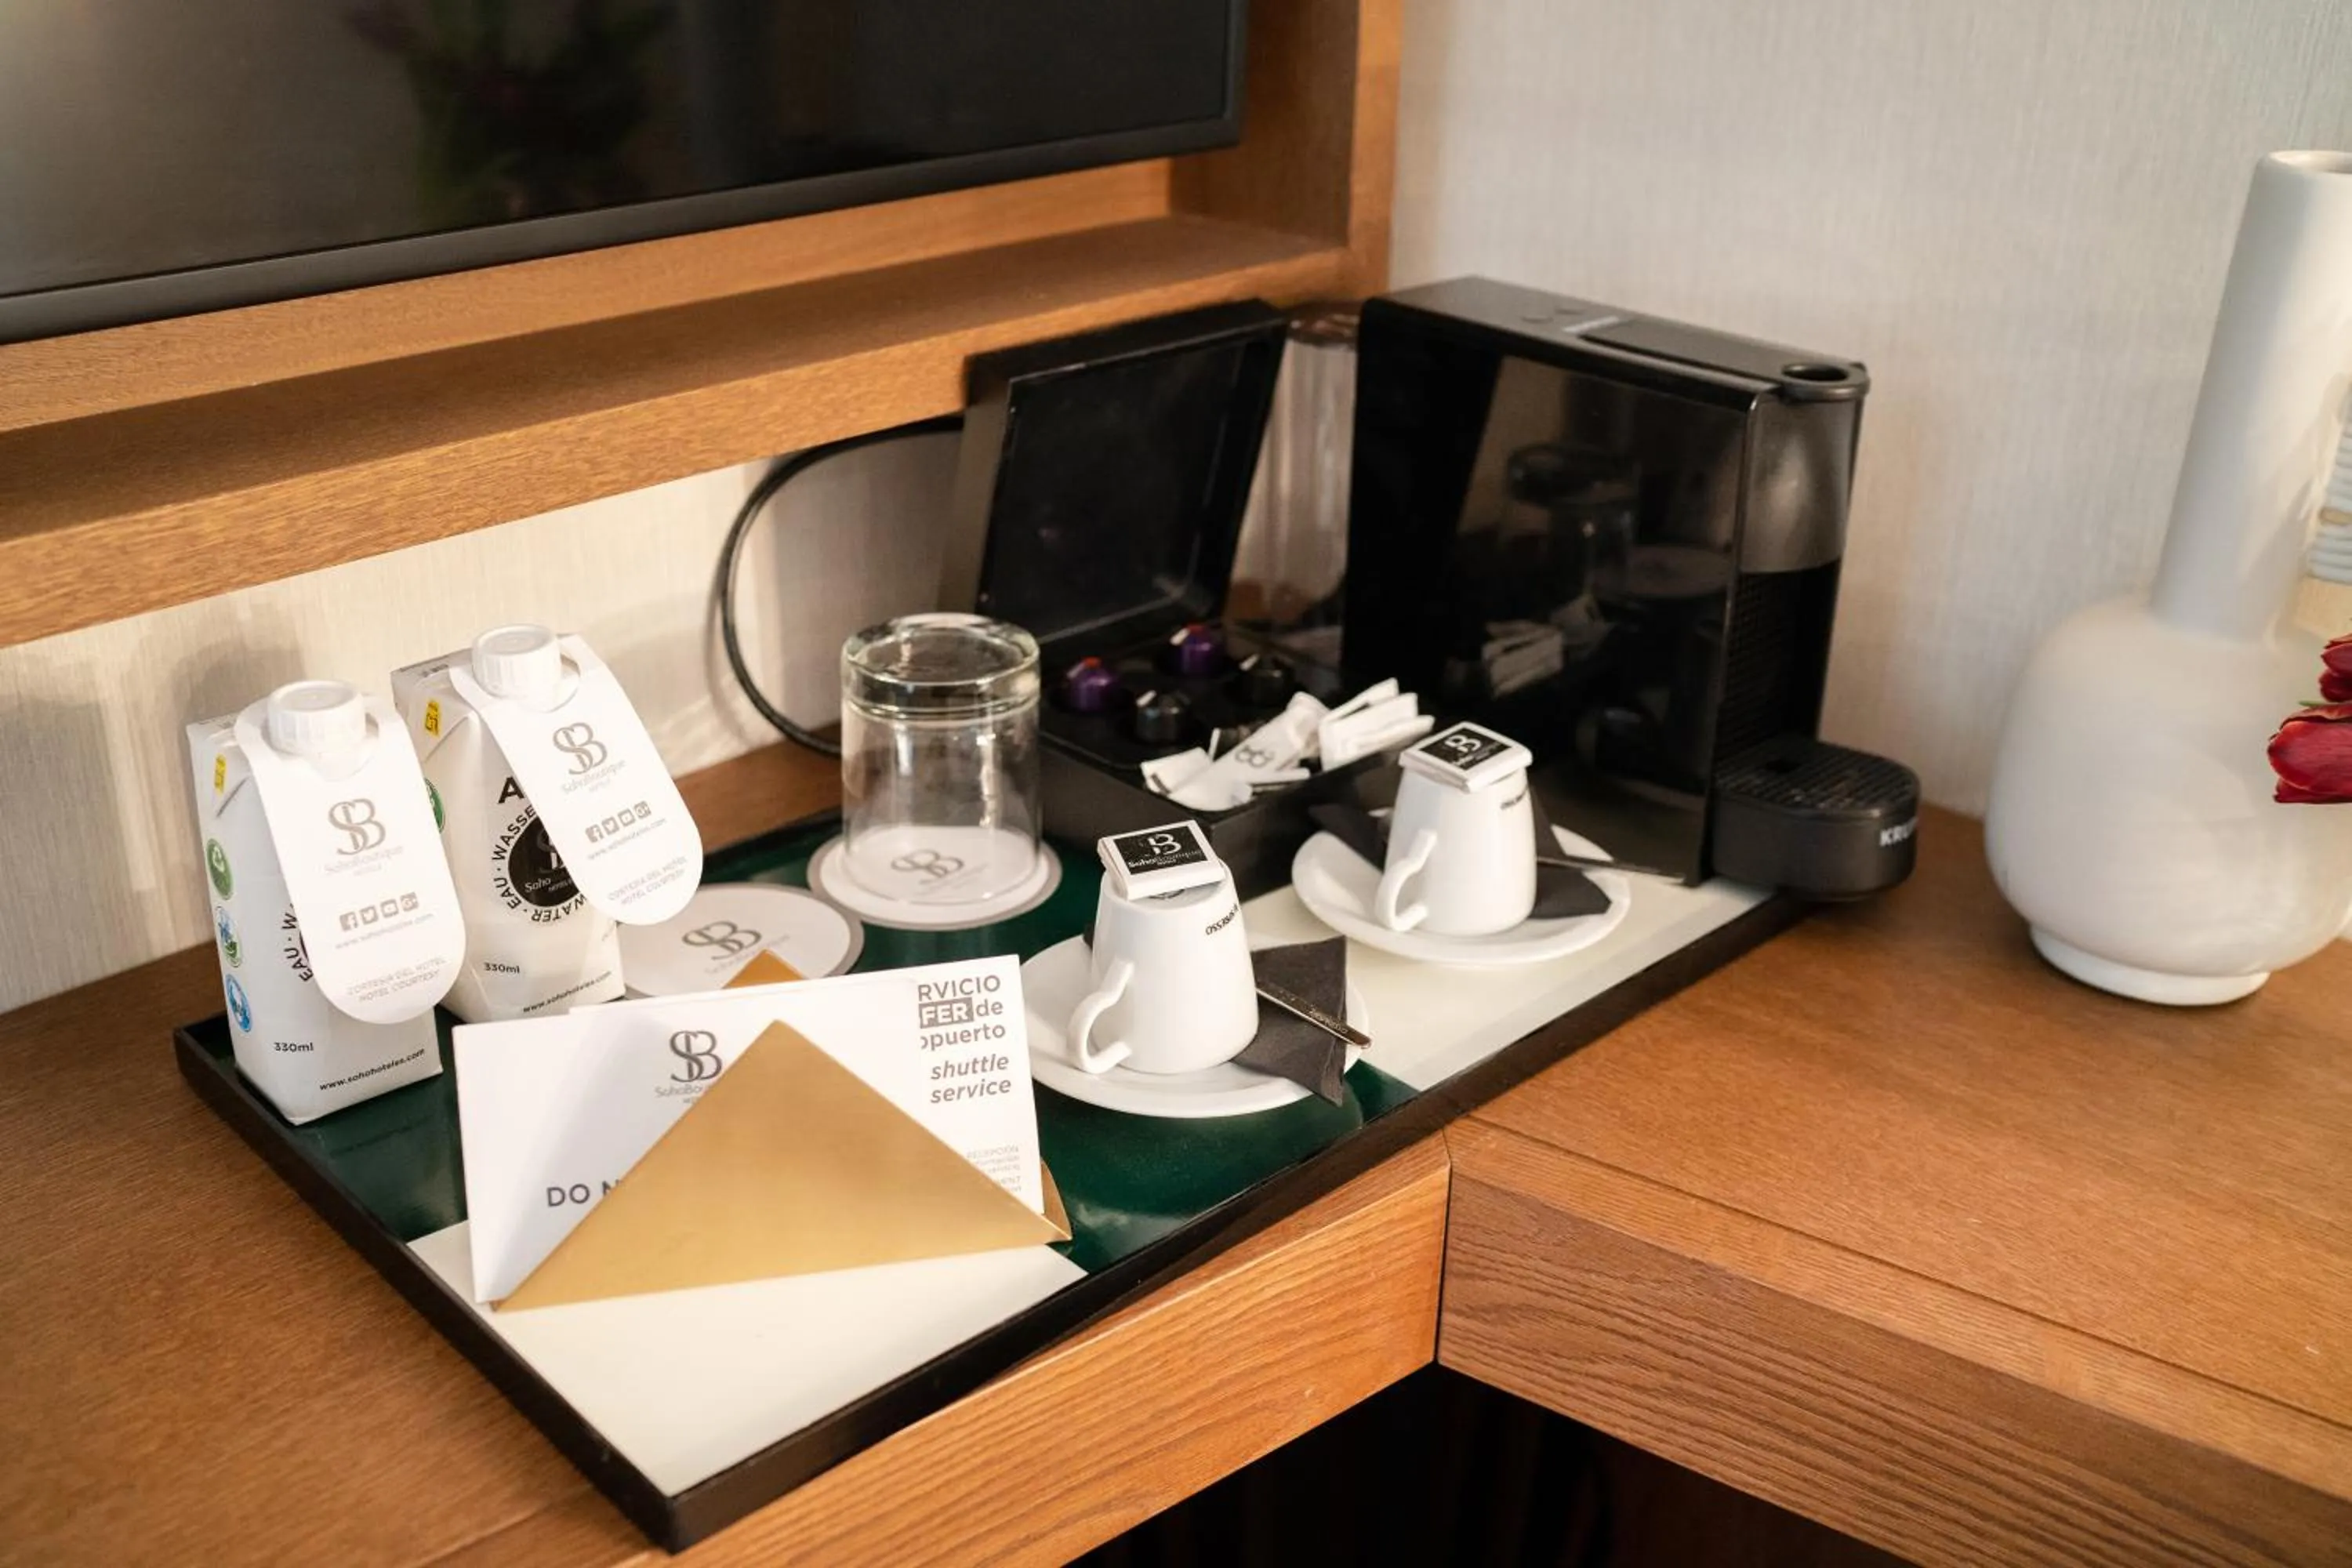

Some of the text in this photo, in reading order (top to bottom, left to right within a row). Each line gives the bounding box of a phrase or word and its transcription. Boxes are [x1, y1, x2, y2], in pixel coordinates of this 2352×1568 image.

[492, 804, 536, 861] WASSE
[493, 877, 522, 909] EAU
[531, 894, 586, 922] WATER
[284, 948, 314, 982] EAU
[484, 962, 520, 974] 330ml
[918, 975, 1000, 1001] RVICIO
[920, 998, 1004, 1026] FER de
[274, 1041, 314, 1052] 330ml
[931, 1054, 1010, 1080] shuttle
[931, 1079, 1011, 1103] service
[546, 1183, 590, 1207] DO
